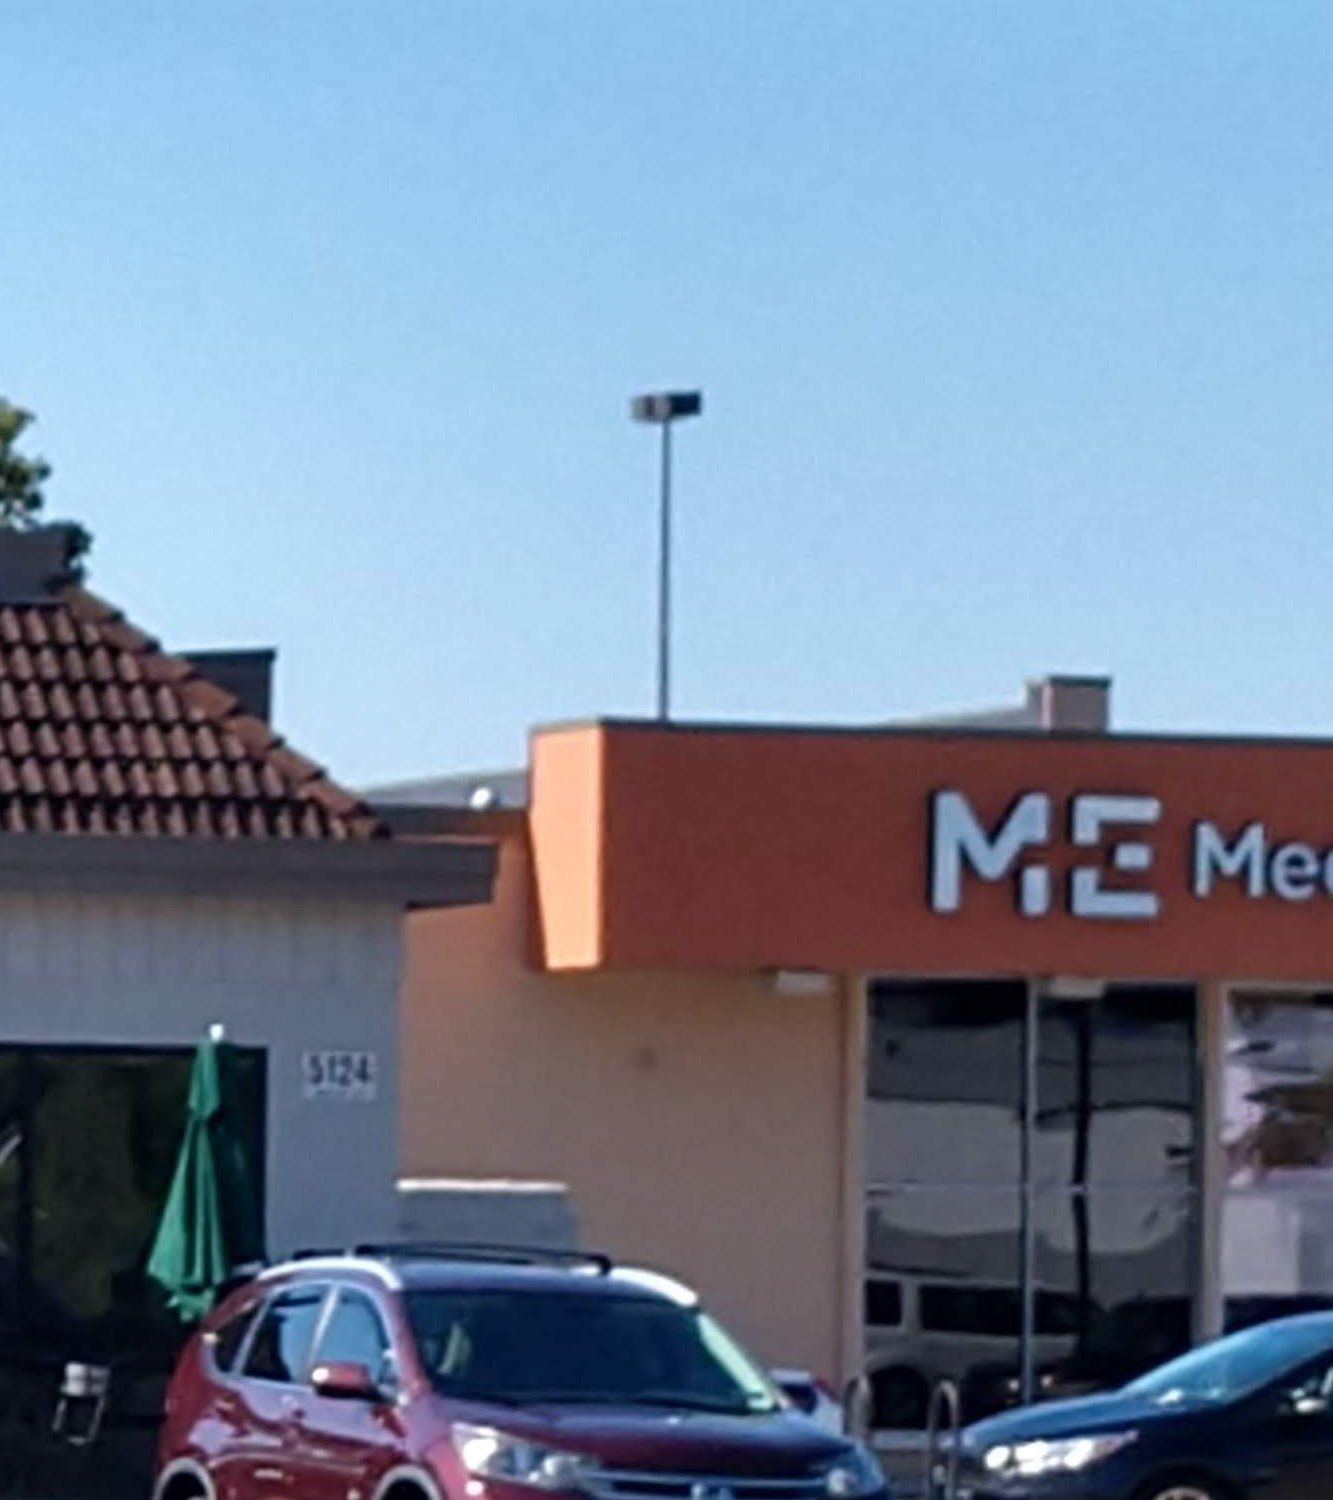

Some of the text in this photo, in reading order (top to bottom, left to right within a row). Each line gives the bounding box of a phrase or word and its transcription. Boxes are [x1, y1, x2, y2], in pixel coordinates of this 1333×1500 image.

[931, 789, 1333, 918] ME Me
[308, 1054, 371, 1087] 5124
